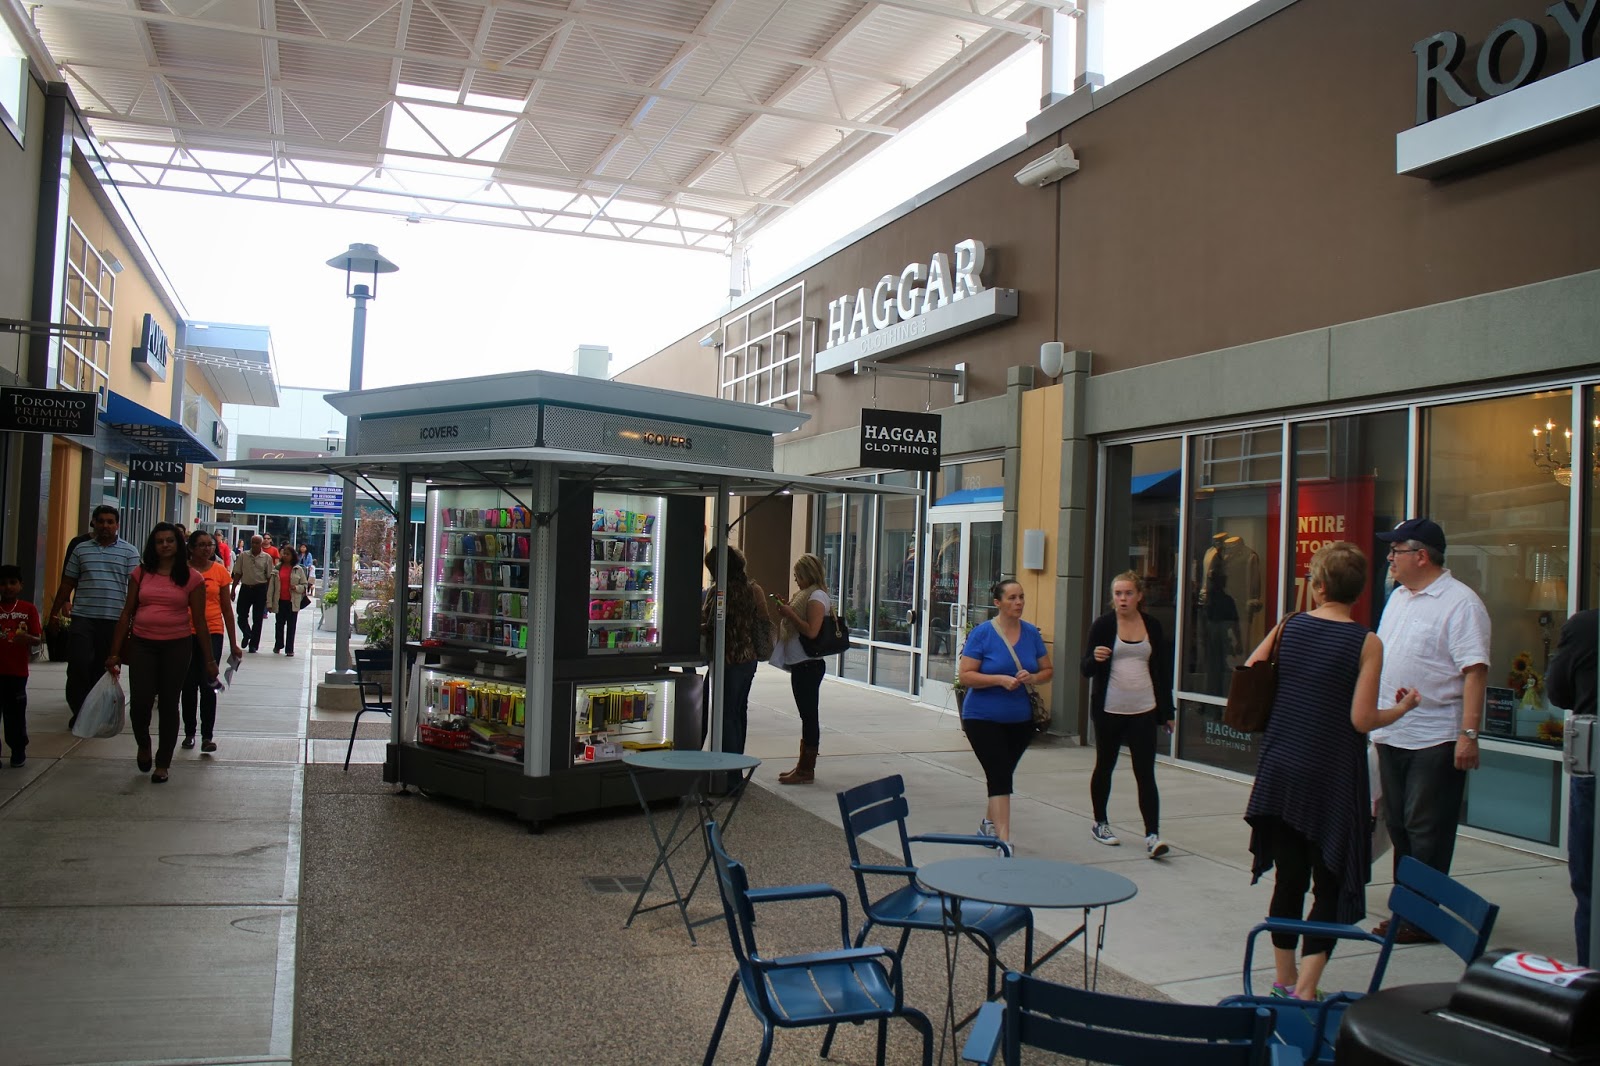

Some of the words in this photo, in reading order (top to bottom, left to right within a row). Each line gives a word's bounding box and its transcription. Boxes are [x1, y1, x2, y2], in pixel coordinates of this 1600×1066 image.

[1412, 0, 1600, 126] ROY
[826, 239, 986, 349] HAGGAR
[861, 321, 919, 353] CLOTHING
[9, 393, 87, 410] TORONTO
[14, 406, 81, 419] PREMIUM
[16, 415, 79, 428] OUTLETS
[419, 425, 459, 440] iCOVERS
[643, 432, 693, 450] iCOVERS
[864, 424, 938, 444] HAGGAR
[864, 442, 930, 455] CLOTHING
[132, 459, 184, 473] PORTS
[1297, 515, 1346, 534] NTIRE
[1206, 721, 1252, 741] HAGGAR
[1205, 736, 1246, 752] CLOTHING
